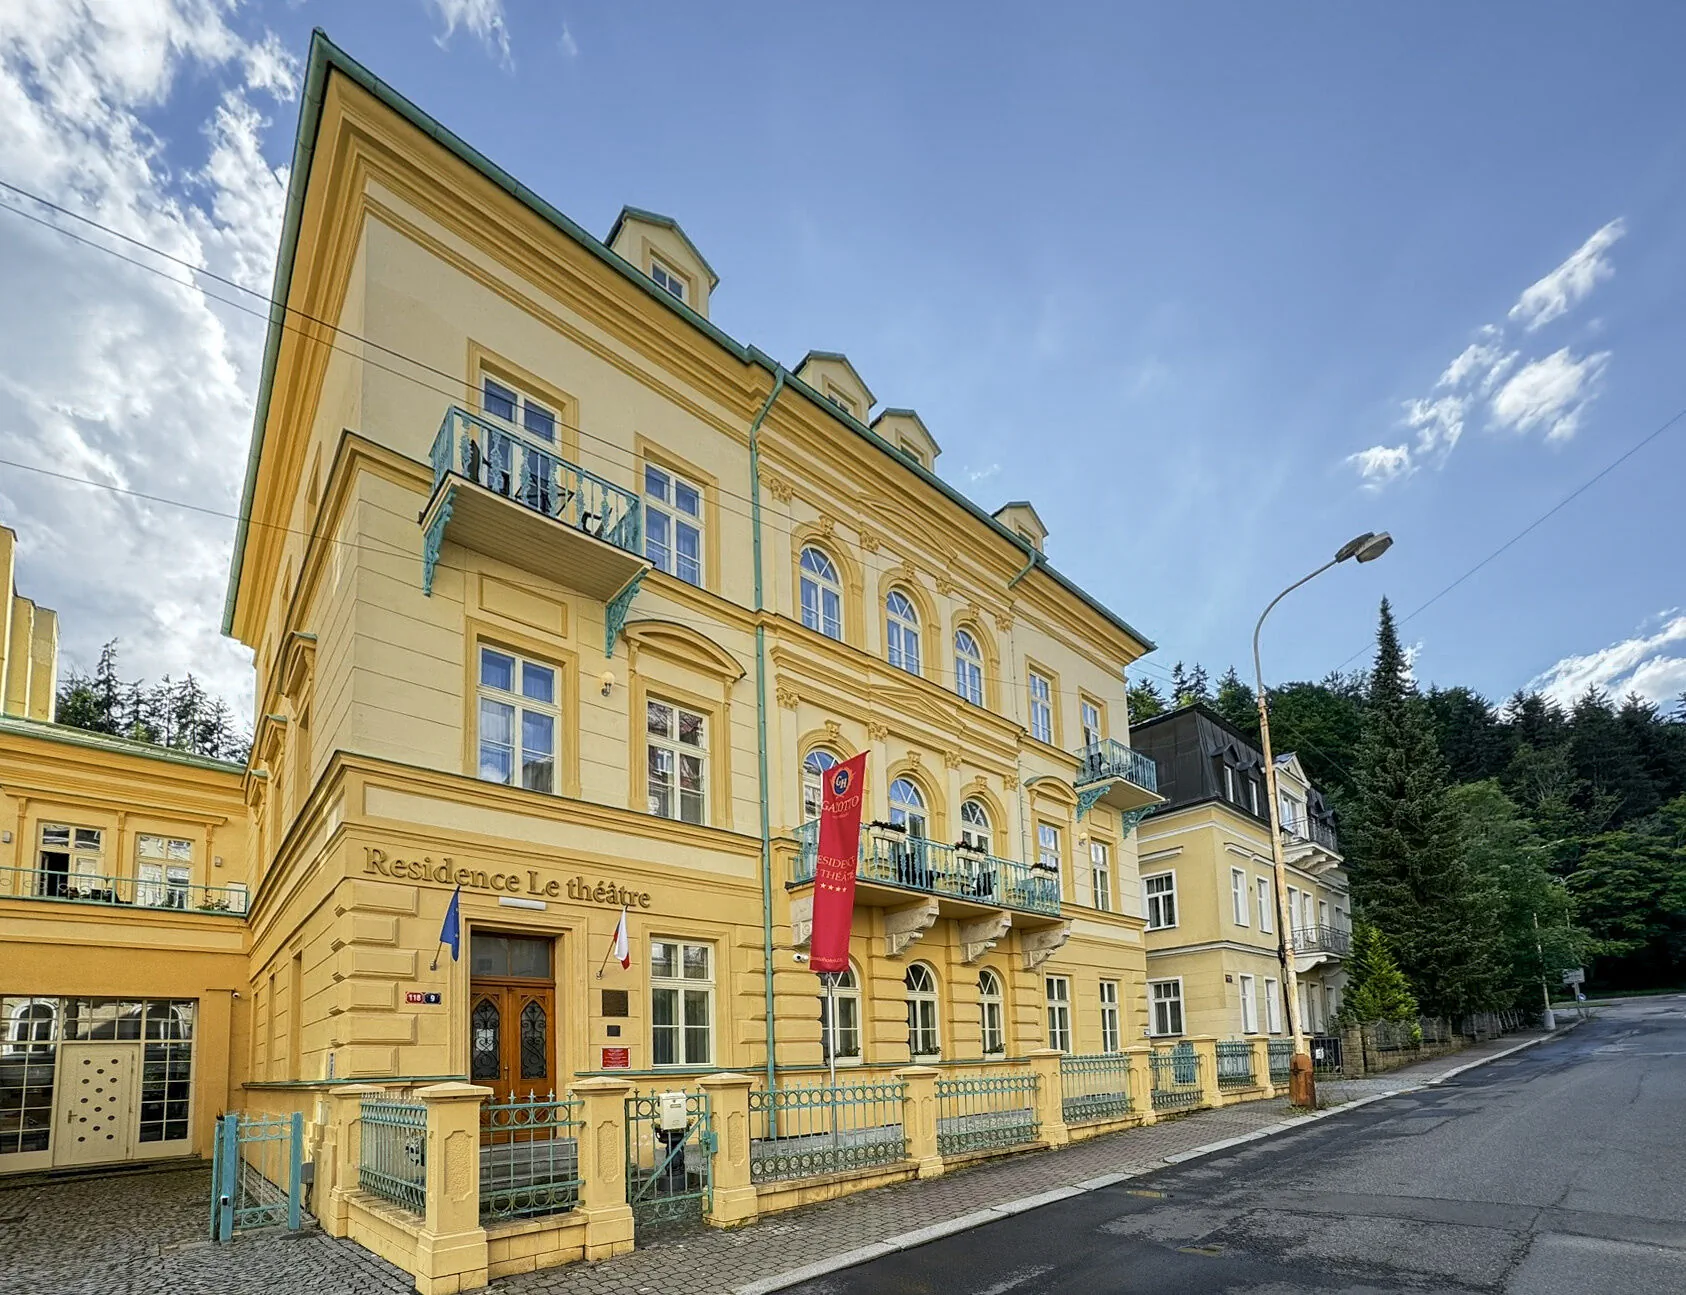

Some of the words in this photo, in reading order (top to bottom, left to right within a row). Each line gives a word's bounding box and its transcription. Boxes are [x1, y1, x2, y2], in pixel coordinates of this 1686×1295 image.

[835, 775, 848, 789] GH
[363, 846, 520, 892] Residence
[527, 870, 561, 897] Le
[566, 876, 652, 909] théâtre
[408, 993, 422, 1002] 118
[430, 994, 436, 1002] 9
